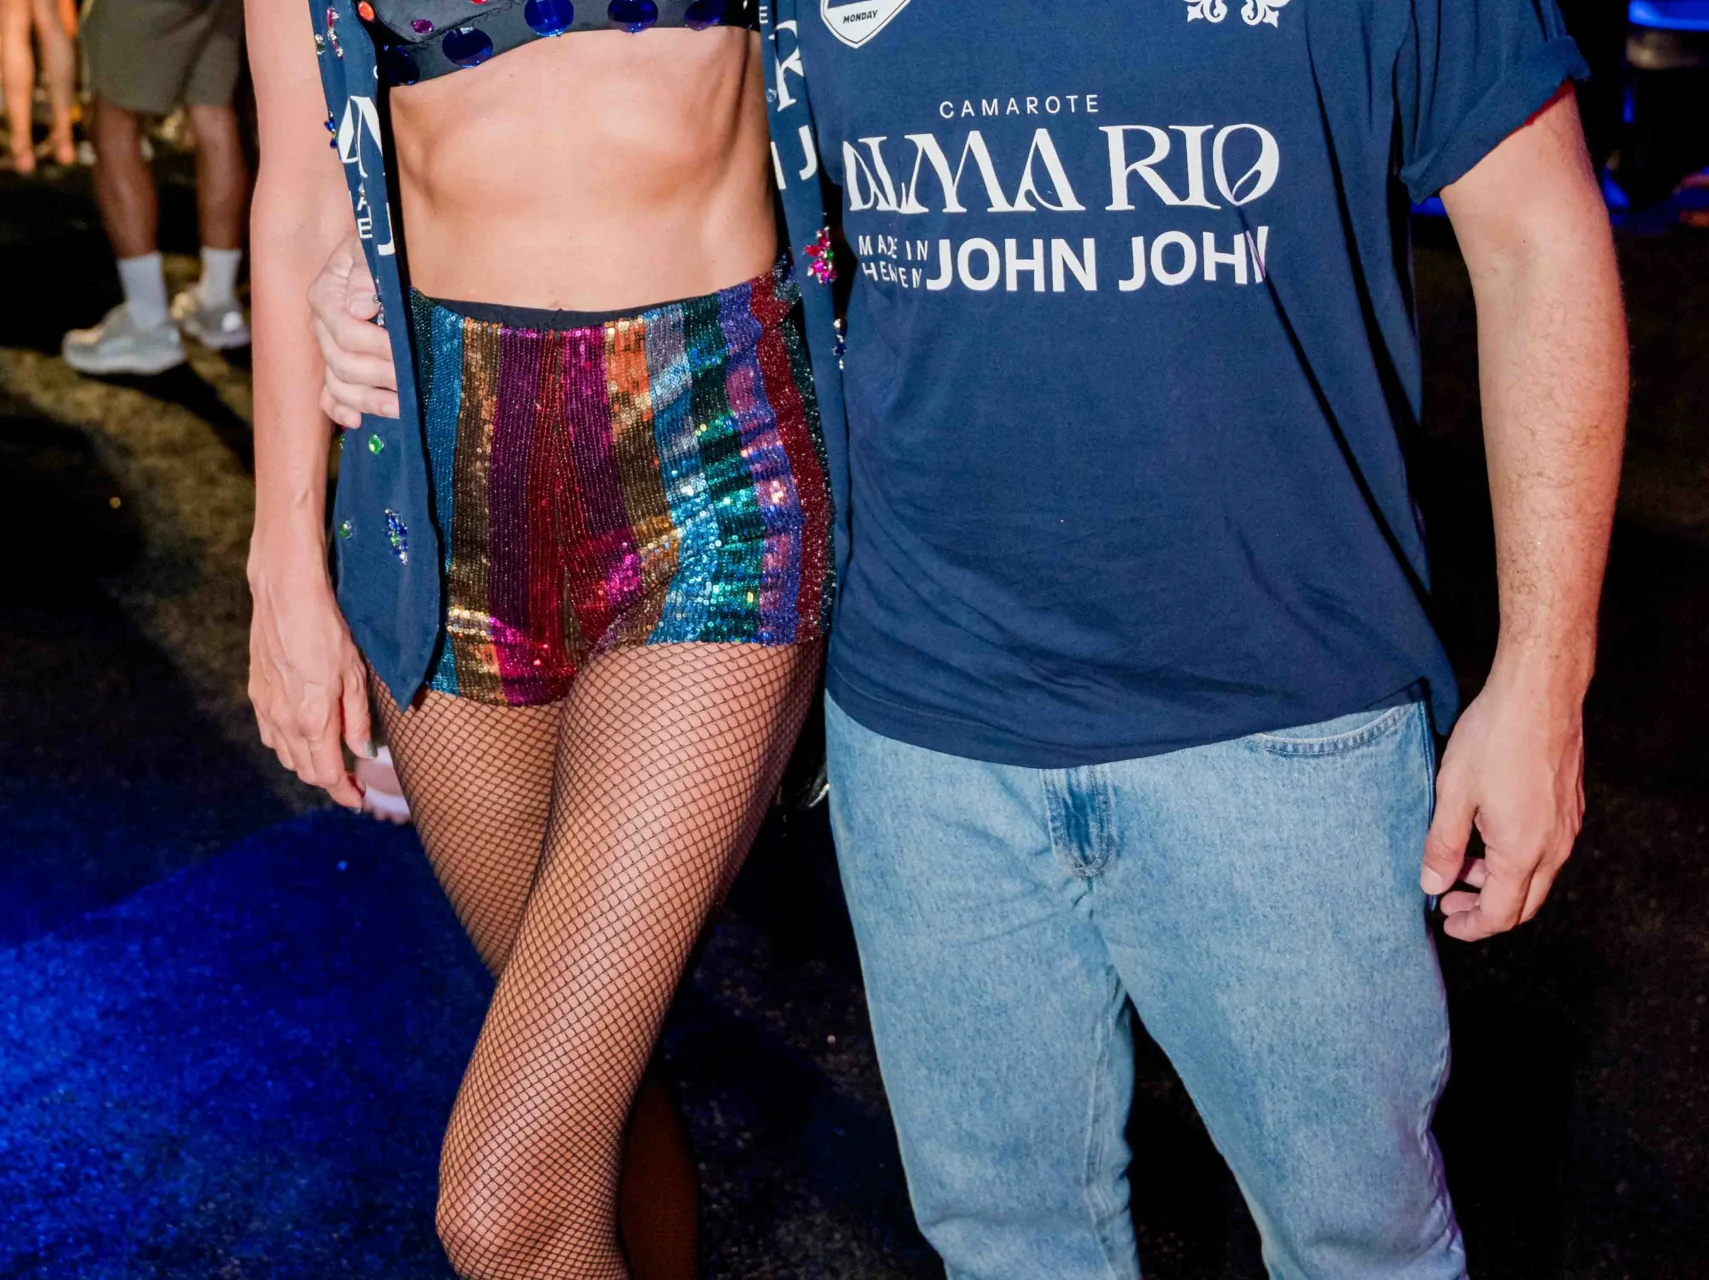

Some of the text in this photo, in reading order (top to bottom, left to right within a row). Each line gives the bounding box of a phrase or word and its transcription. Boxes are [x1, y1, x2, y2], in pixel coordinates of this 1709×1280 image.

[843, 9, 878, 24] MONDAY
[940, 95, 1098, 118] CAMAROTE
[1098, 123, 1279, 210] RIO
[859, 234, 928, 261] MADE IN
[926, 226, 1269, 292] JOHN JOHN
